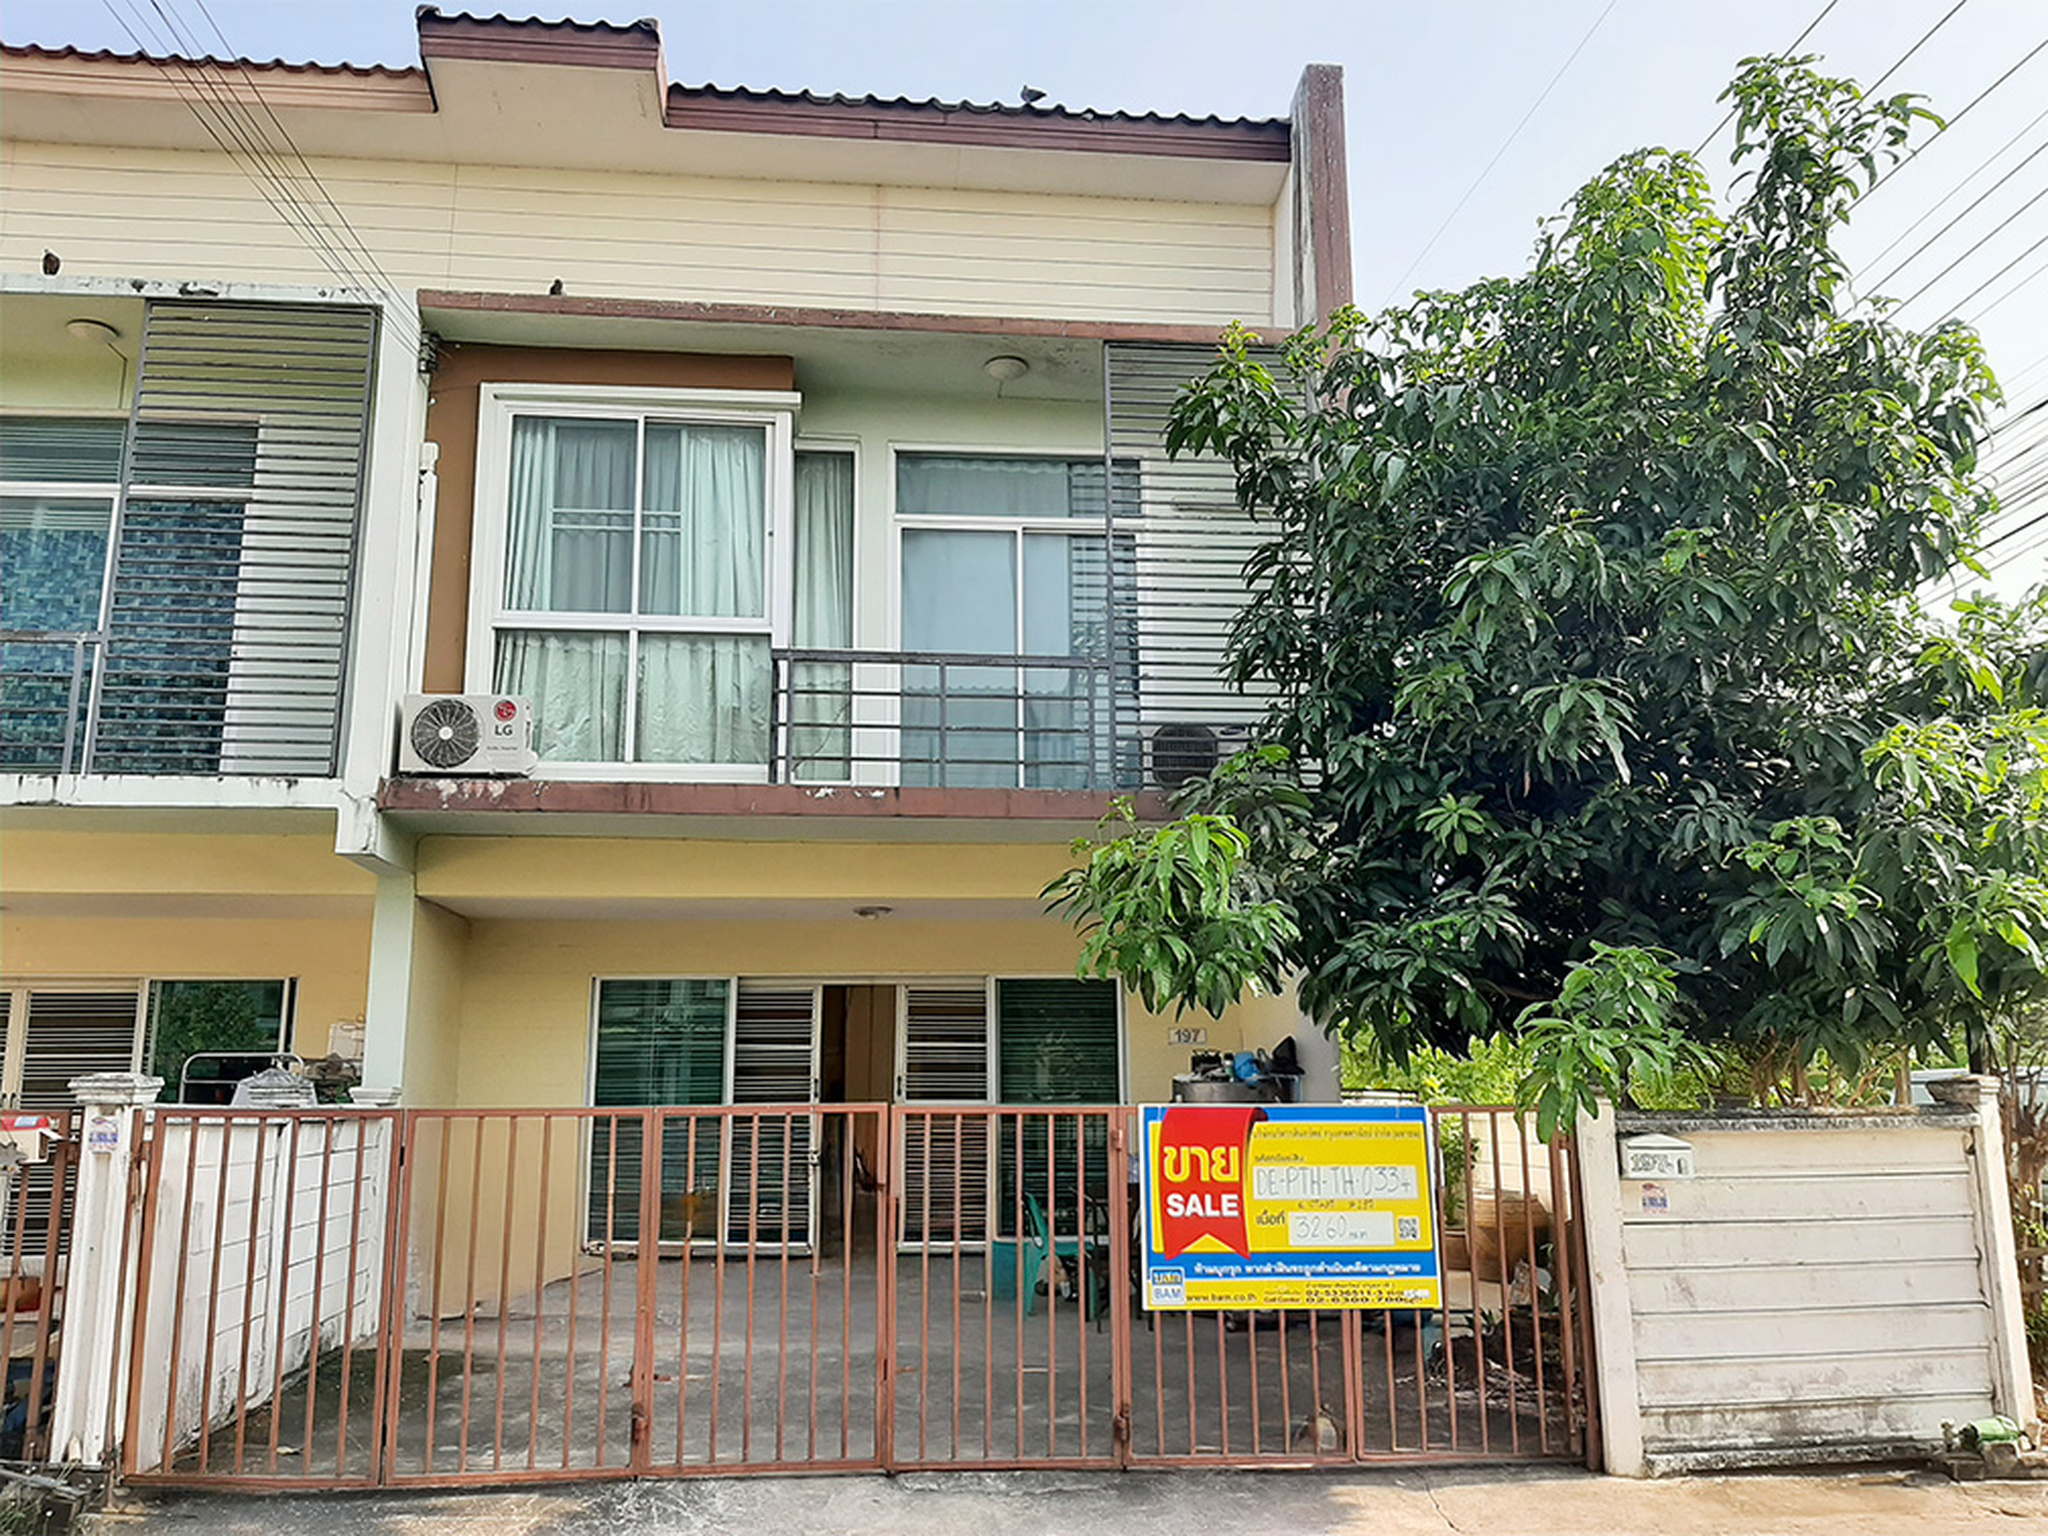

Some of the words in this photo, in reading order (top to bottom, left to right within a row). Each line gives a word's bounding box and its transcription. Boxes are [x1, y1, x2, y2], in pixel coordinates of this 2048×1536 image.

[494, 724, 513, 736] LG
[1174, 1028, 1201, 1043] 197
[1163, 1146, 1240, 1182] ขาย
[1166, 1193, 1240, 1218] SALE
[1153, 1287, 1182, 1300] BAM
